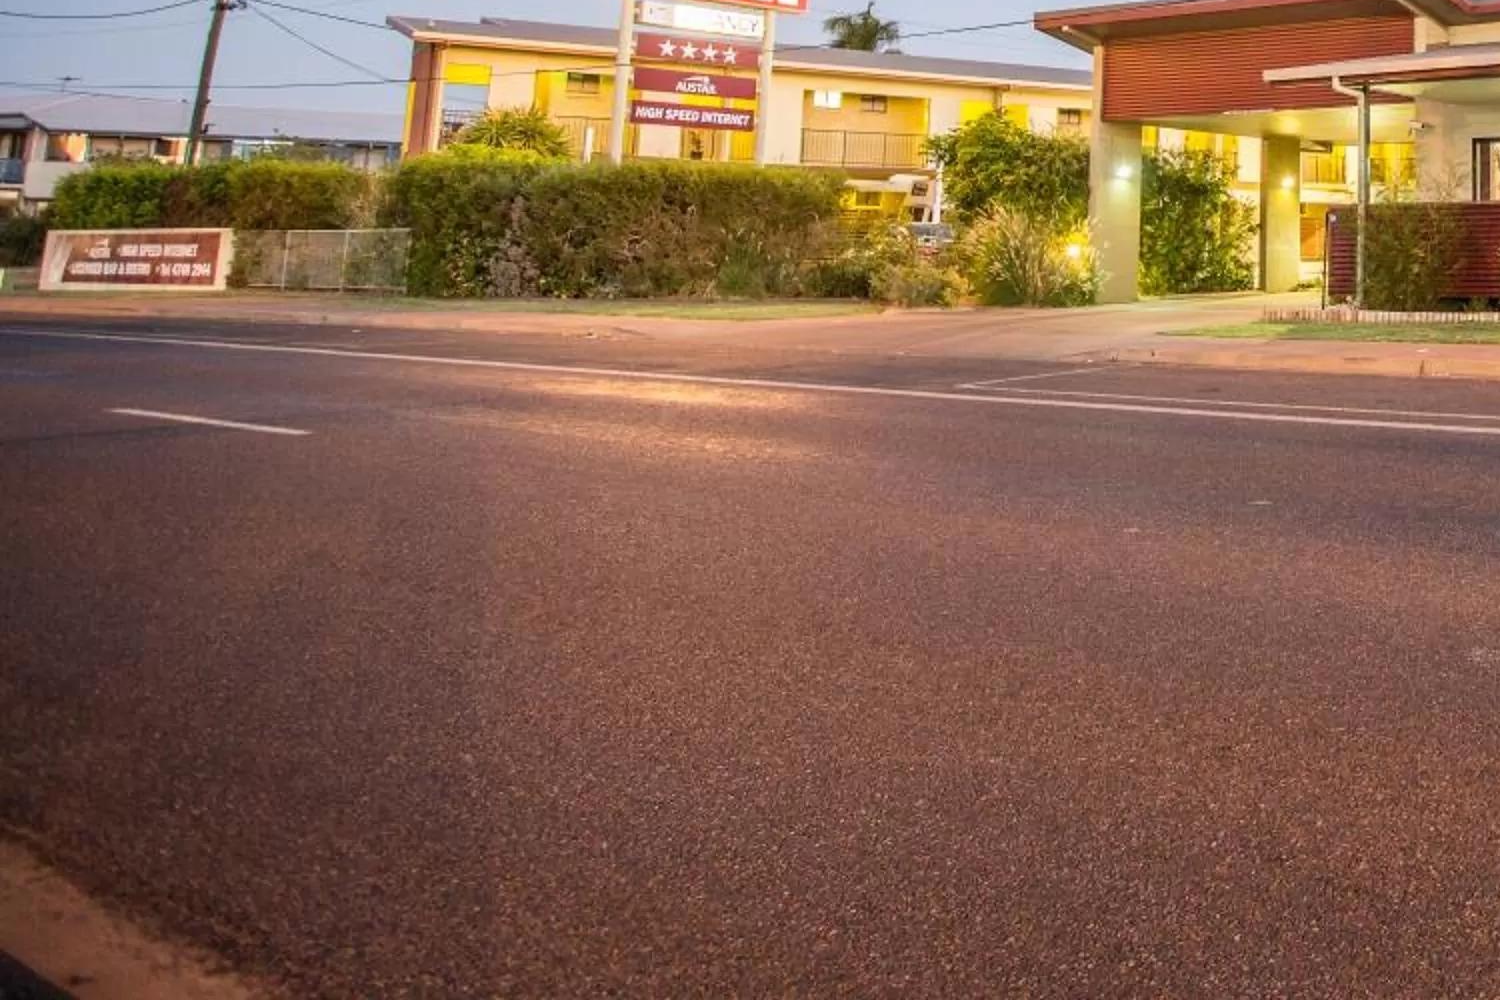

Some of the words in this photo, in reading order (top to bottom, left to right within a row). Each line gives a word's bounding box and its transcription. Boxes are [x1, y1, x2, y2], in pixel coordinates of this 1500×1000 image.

[635, 106, 664, 119] HIGH
[665, 108, 699, 121] SPEED
[701, 111, 750, 126] INTERNET
